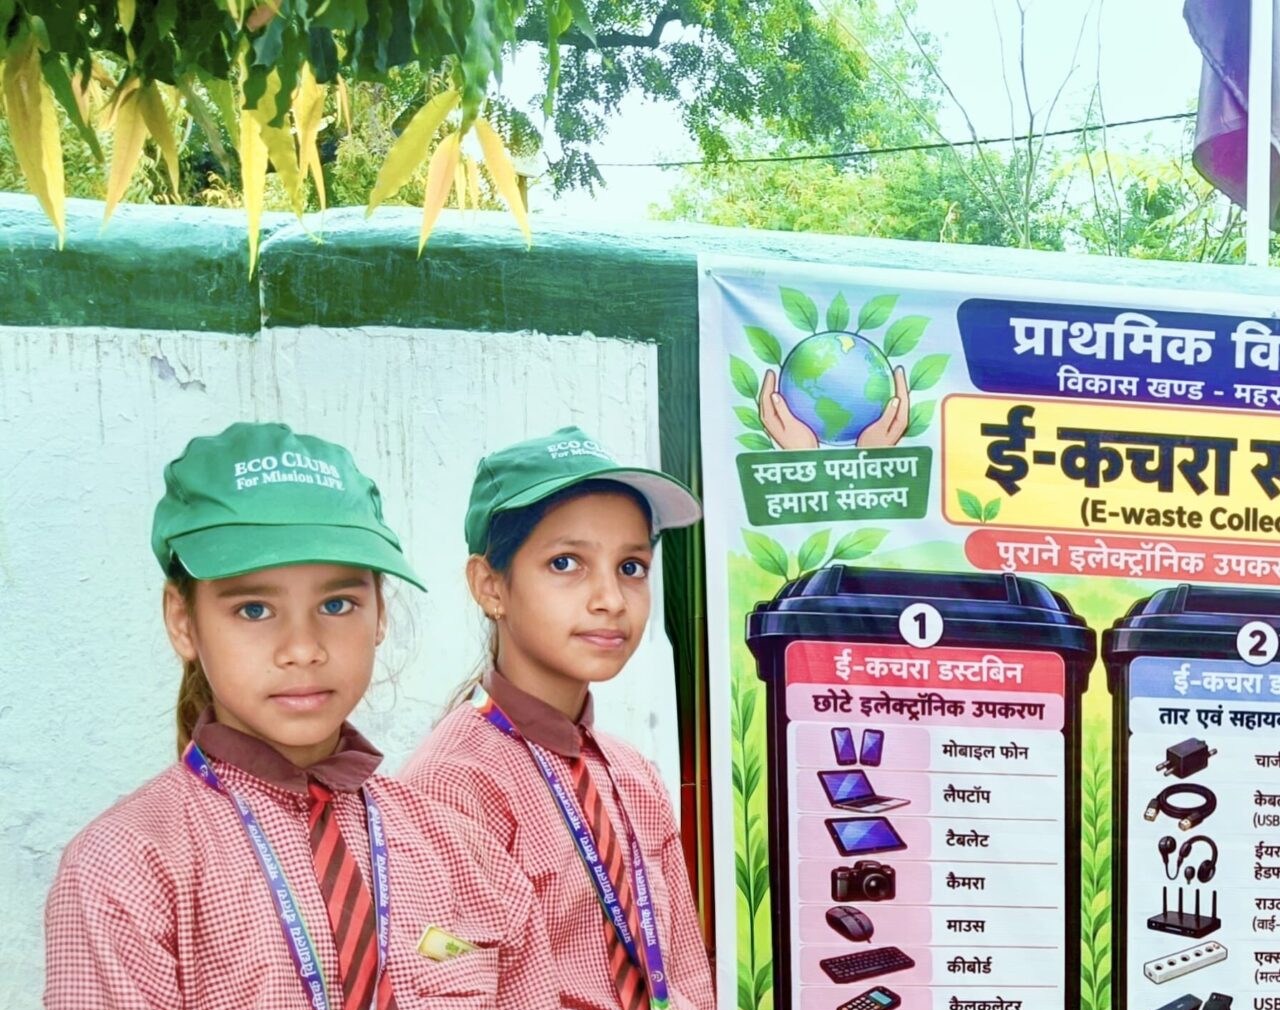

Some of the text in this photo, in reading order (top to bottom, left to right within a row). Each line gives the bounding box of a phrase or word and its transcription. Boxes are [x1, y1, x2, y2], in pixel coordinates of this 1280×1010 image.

[1010, 312, 1215, 366] प्राथमिक
[1057, 365, 1137, 397] विकास
[1147, 374, 1204, 400] खण्ड
[981, 404, 1238, 497] ई-कचरा
[234, 451, 340, 479] ECO CLUBS
[751, 455, 917, 484] स्वच्छ पर्यावरण
[237, 471, 314, 490] For Mission
[765, 486, 909, 518] हमारा संकल्प
[1080, 498, 1202, 530] (E-waste
[996, 537, 1060, 574] पुराने
[1070, 539, 1204, 578] इलेक्ट्रॉनिक
[912, 612, 927, 639] 1
[1249, 630, 1267, 657] 2
[833, 649, 1023, 683] ई-कचरा डस्टबिन
[1173, 663, 1262, 694] ई-कचरा
[813, 689, 1045, 721] छोटे इलेक्ट्रॉनिक उपकरण
[1159, 707, 1190, 725] तार
[1196, 704, 1224, 728] एवं
[942, 740, 1029, 760] मोबाइल फोन
[943, 785, 991, 804] लैपटॉप
[945, 830, 990, 847] टैबलेट
[946, 873, 985, 890] कैमरा
[946, 918, 985, 933] माउस
[947, 956, 992, 974] कीबोर्ड
